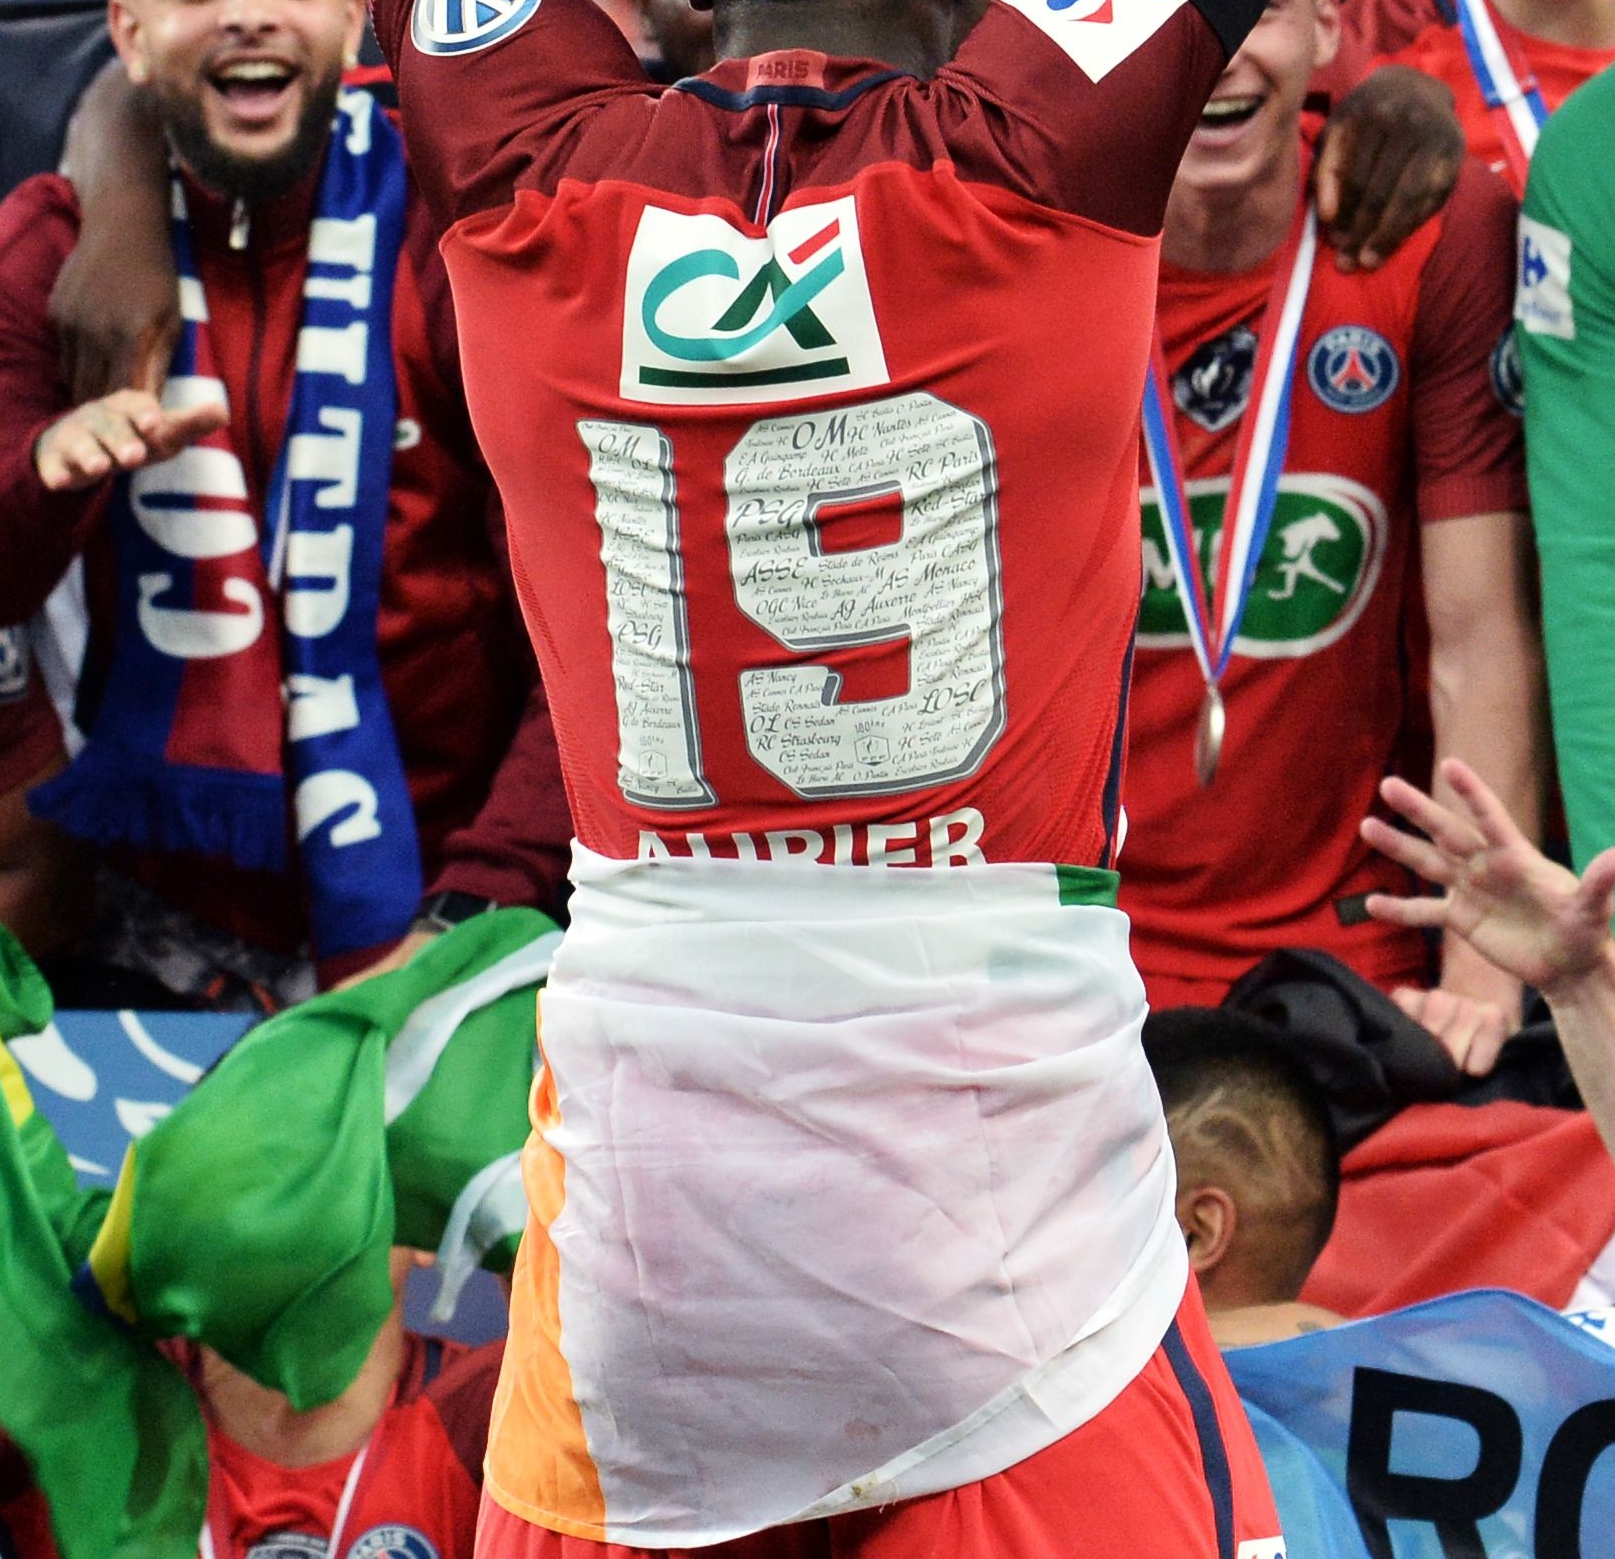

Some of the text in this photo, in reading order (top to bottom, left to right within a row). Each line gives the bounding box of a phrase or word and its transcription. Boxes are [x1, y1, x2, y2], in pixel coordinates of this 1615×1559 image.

[792, 413, 848, 450] OM
[873, 419, 912, 438] Nantes
[598, 433, 641, 459] OM
[757, 467, 772, 480] de
[779, 463, 839, 480] Bordeaux
[906, 458, 933, 481] RC
[938, 451, 978, 473] Paris
[732, 498, 805, 528] PSG
[910, 492, 986, 516] Red-Star
[740, 556, 808, 586] ASSE
[878, 559, 976, 595] AS Monaco
[576, 391, 1008, 810] 19
[792, 595, 818, 612] Nice
[860, 592, 918, 617] Auxerre
[617, 620, 662, 650] PSG
[917, 678, 987, 714] LOSC
[750, 713, 781, 733] OL
[781, 733, 841, 748] Strasbourg
